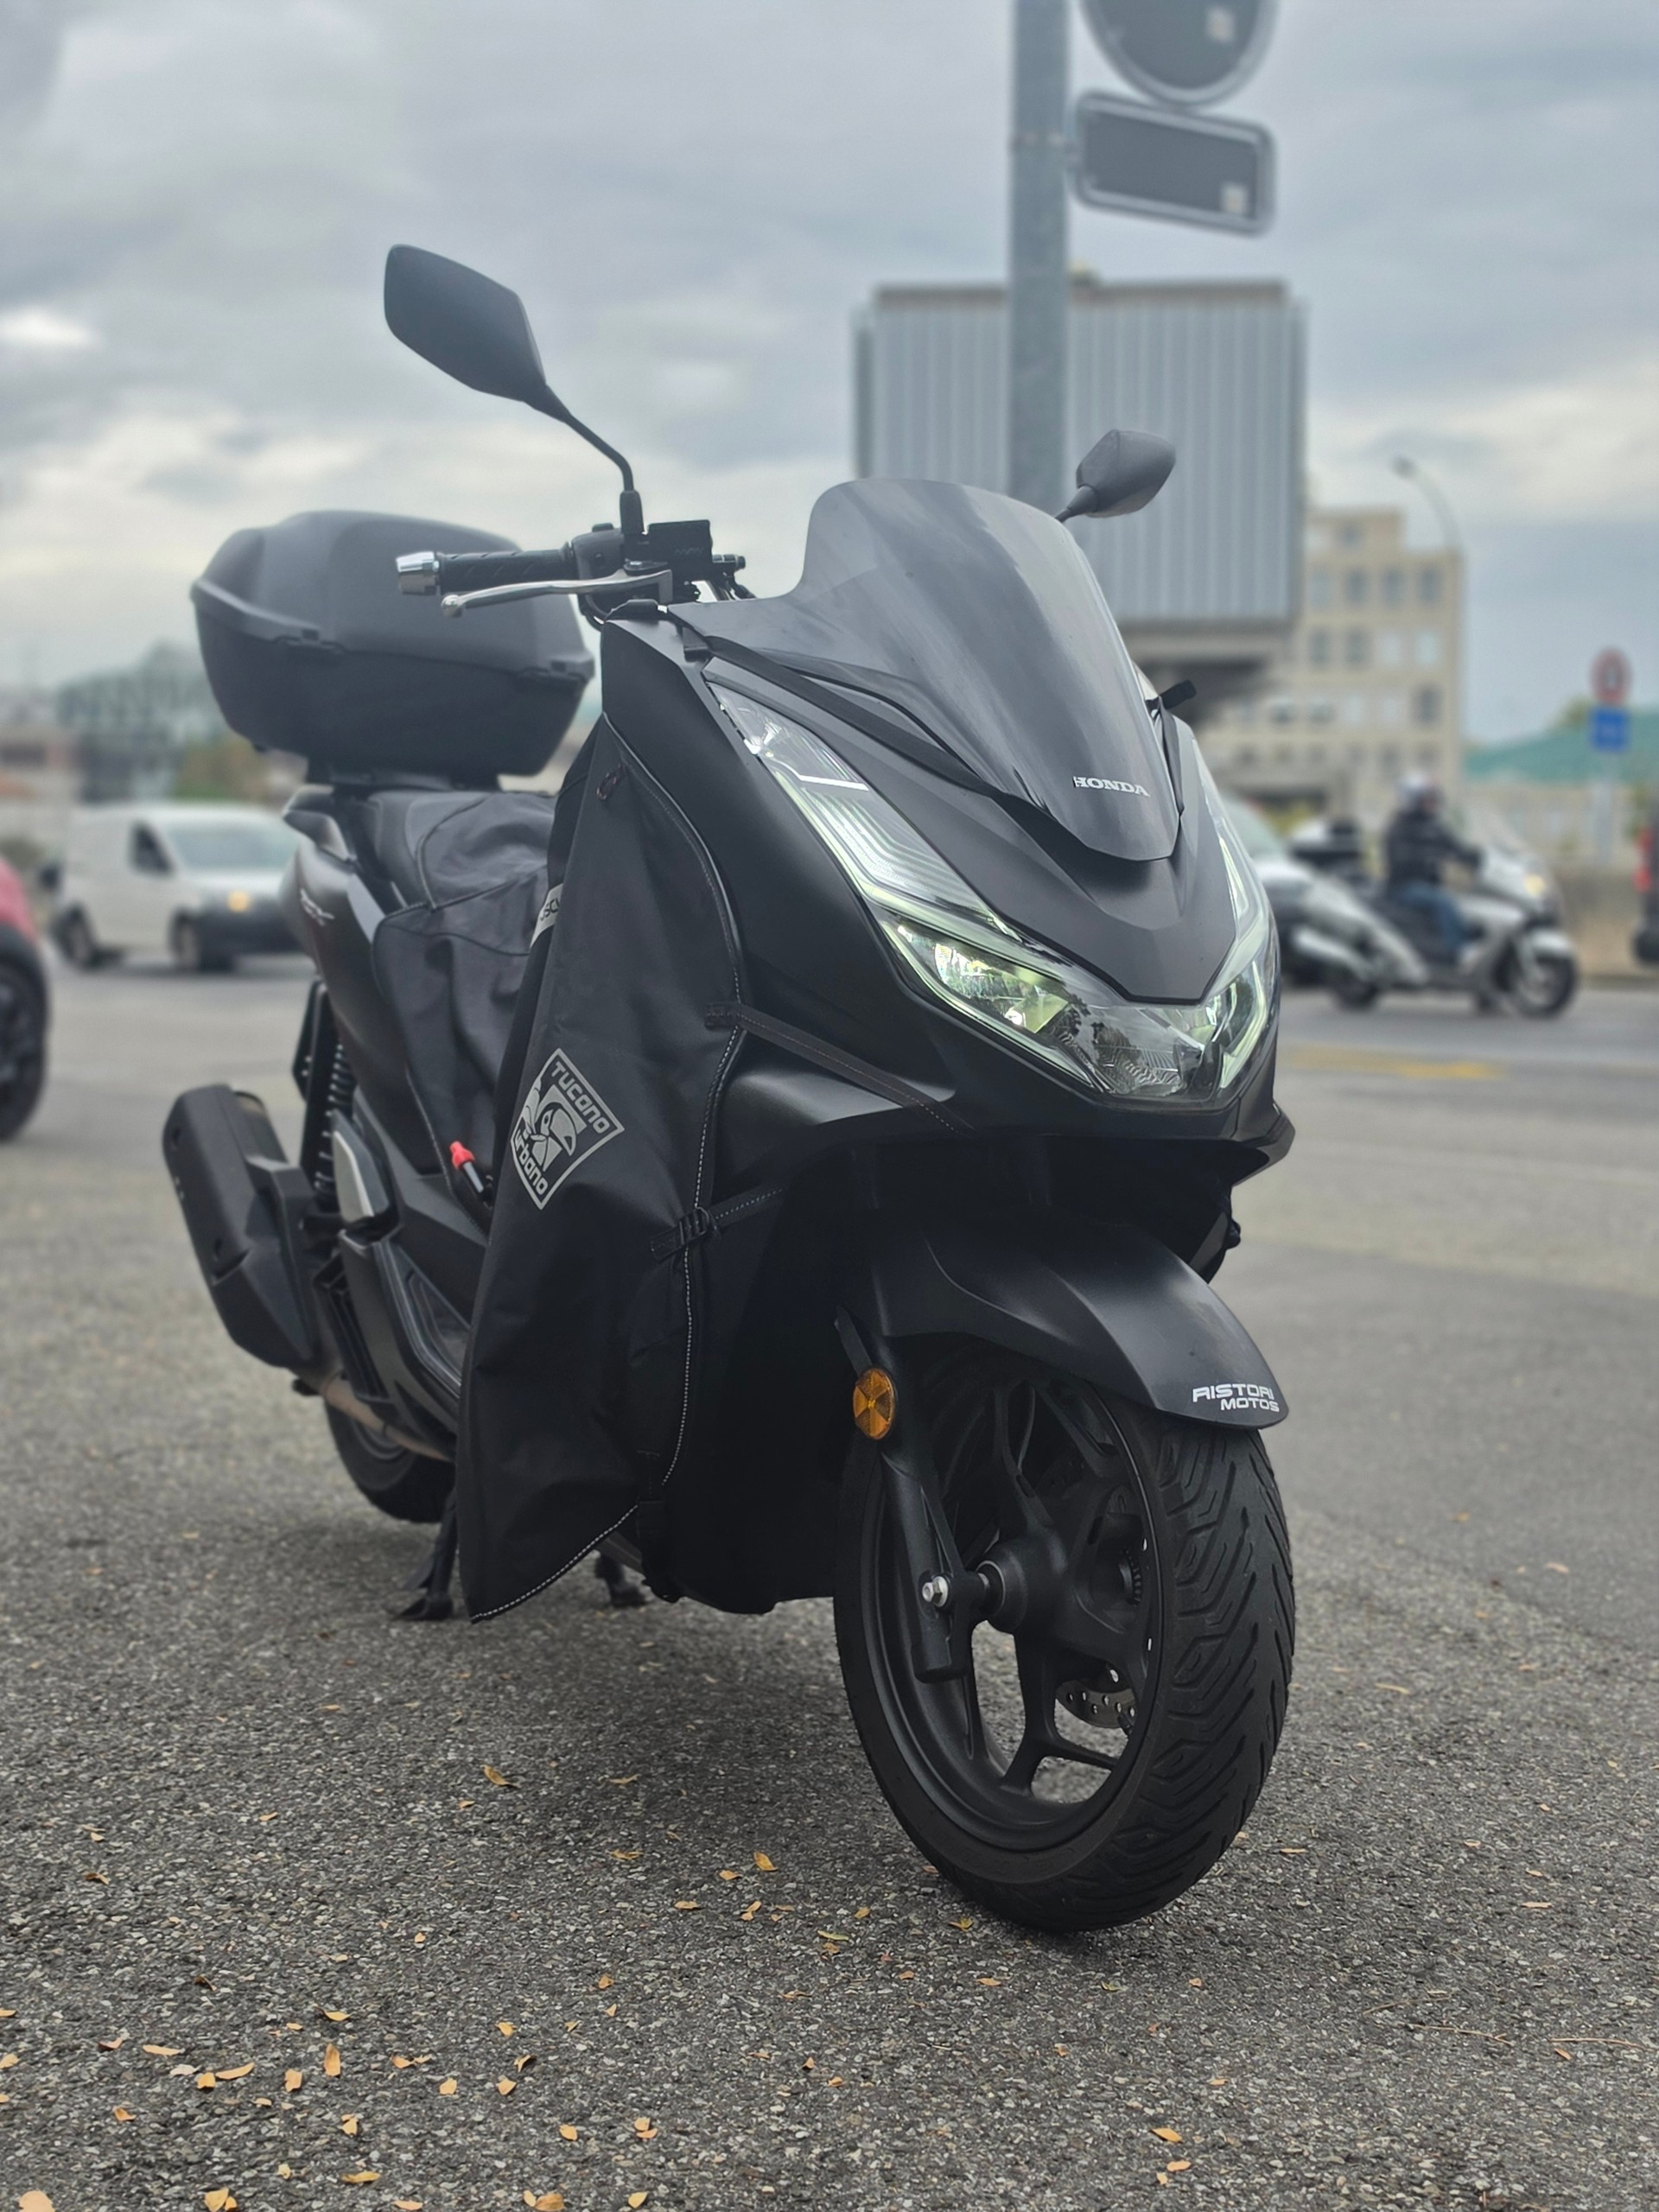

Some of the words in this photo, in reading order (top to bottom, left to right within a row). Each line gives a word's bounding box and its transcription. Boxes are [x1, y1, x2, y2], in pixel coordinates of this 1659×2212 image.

[1072, 776, 1151, 798] HONDA
[1192, 1383, 1274, 1402] RISTORI
[1220, 1397, 1280, 1412] MOTOS
